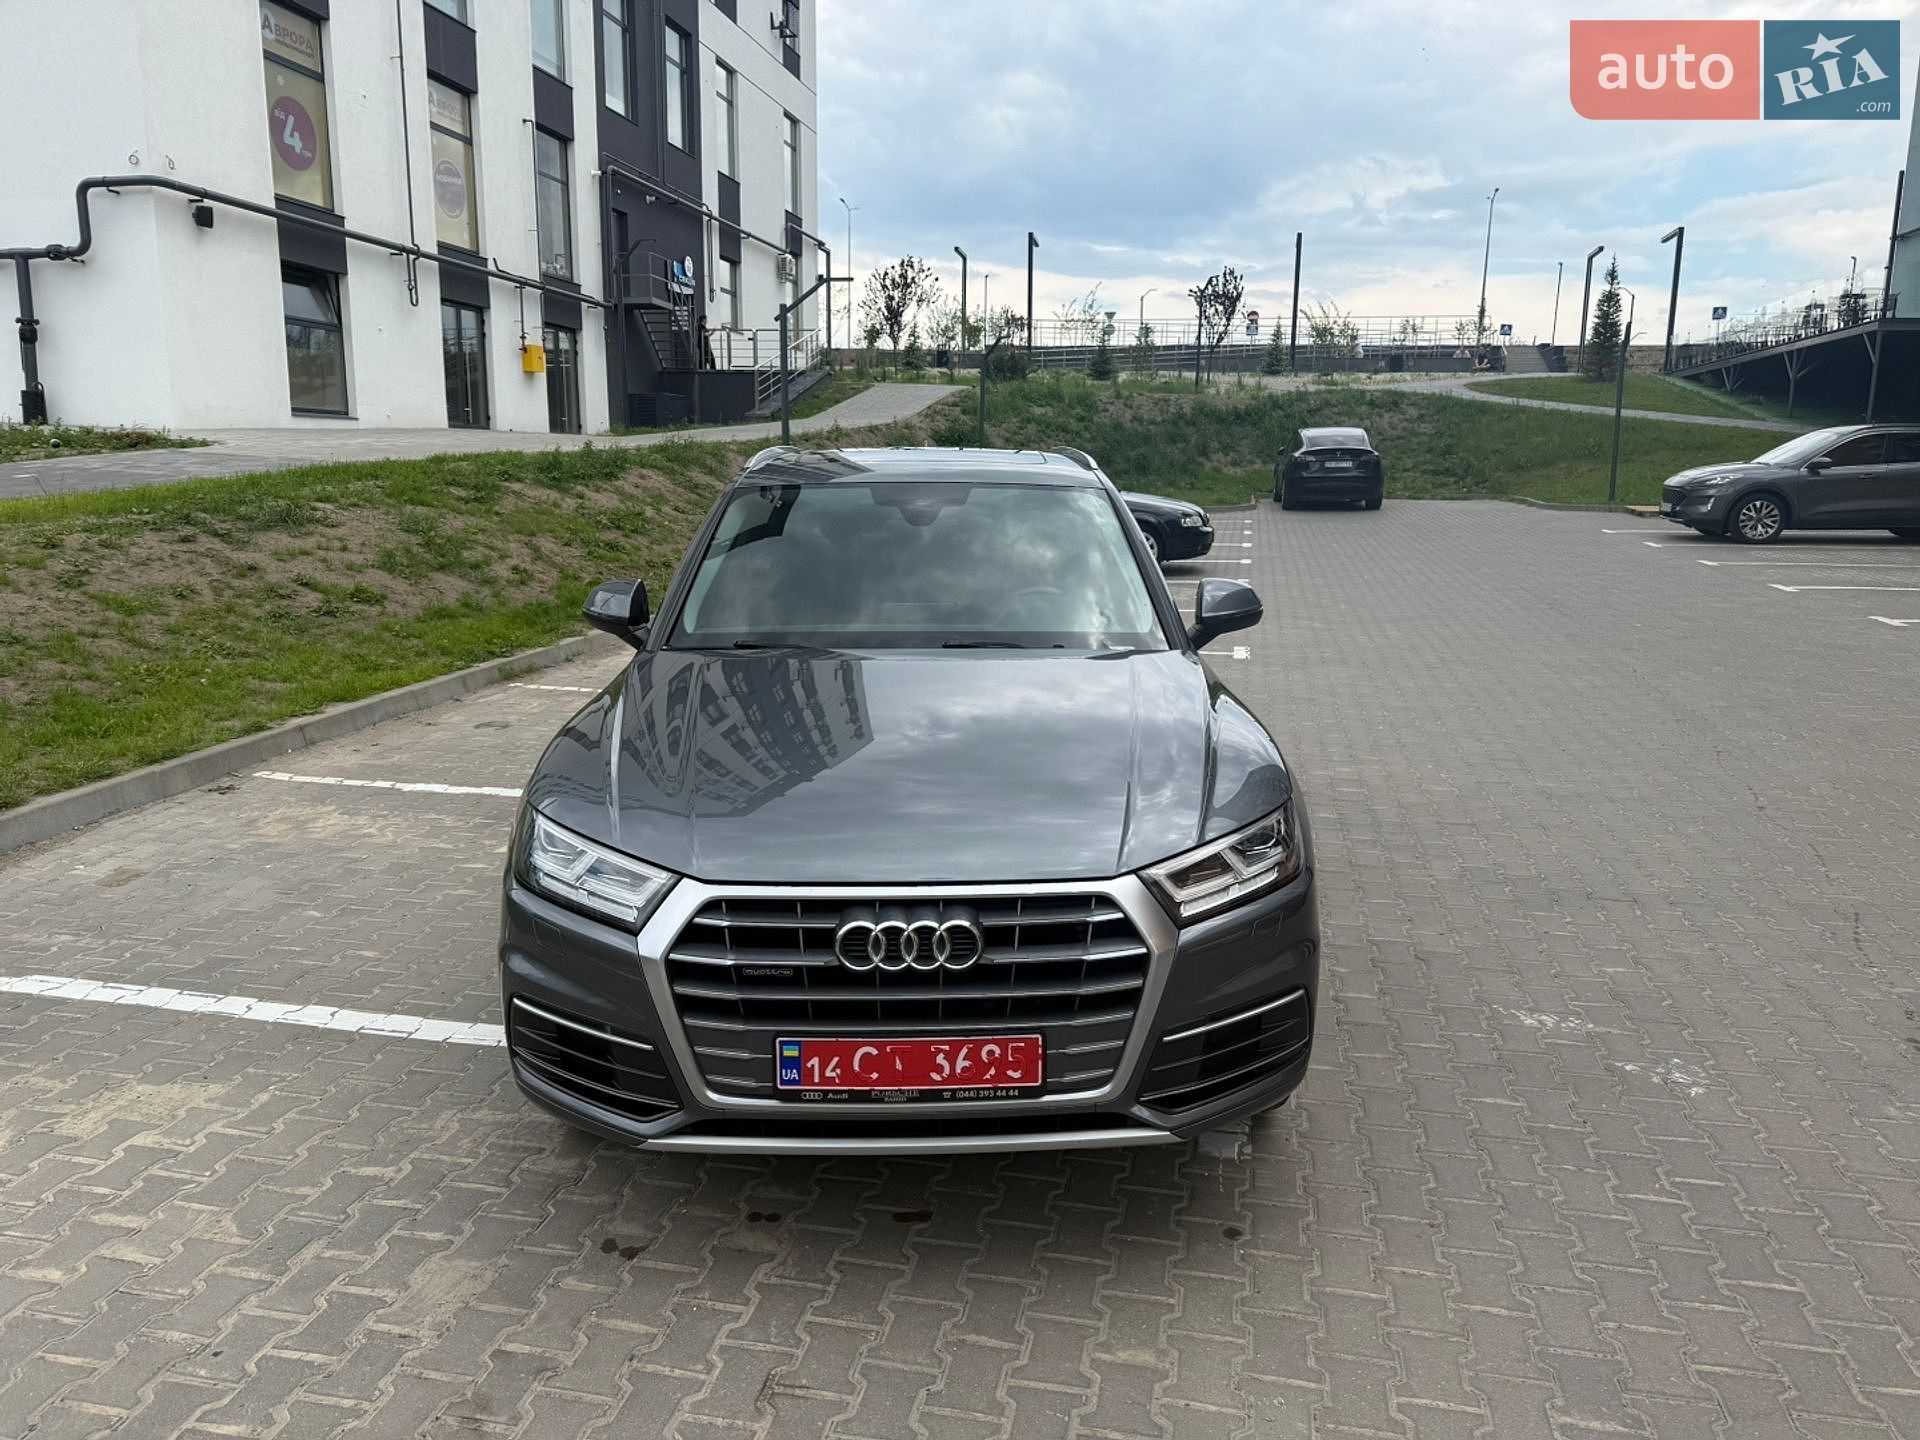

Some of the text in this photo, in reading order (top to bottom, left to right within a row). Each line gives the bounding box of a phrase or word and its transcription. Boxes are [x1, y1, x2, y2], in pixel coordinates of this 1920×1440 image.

[283, 114, 303, 154] 4
[806, 1056, 841, 1084] 14
[929, 1042, 1026, 1081] 3695
[782, 1069, 799, 1080] UA
[827, 1092, 849, 1100] Audi
[1008, 1086, 1019, 1097] 44
